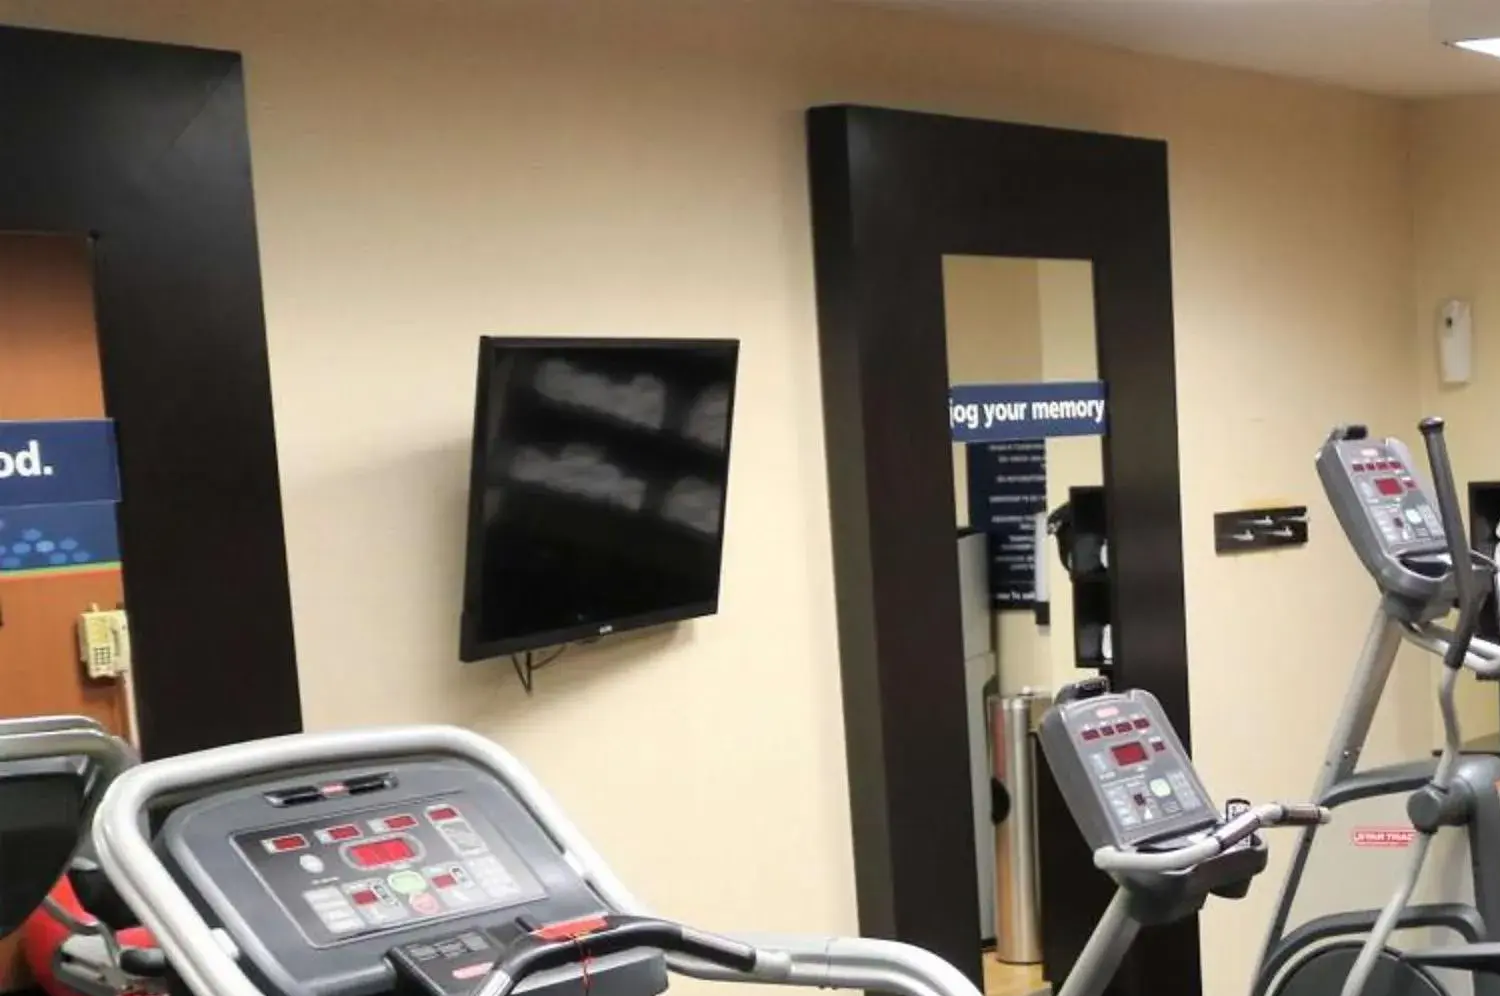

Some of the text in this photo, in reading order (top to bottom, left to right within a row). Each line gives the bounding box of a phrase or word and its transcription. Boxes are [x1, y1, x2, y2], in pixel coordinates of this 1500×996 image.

[949, 397, 1105, 429] jog your memory
[0, 439, 54, 478] od.
